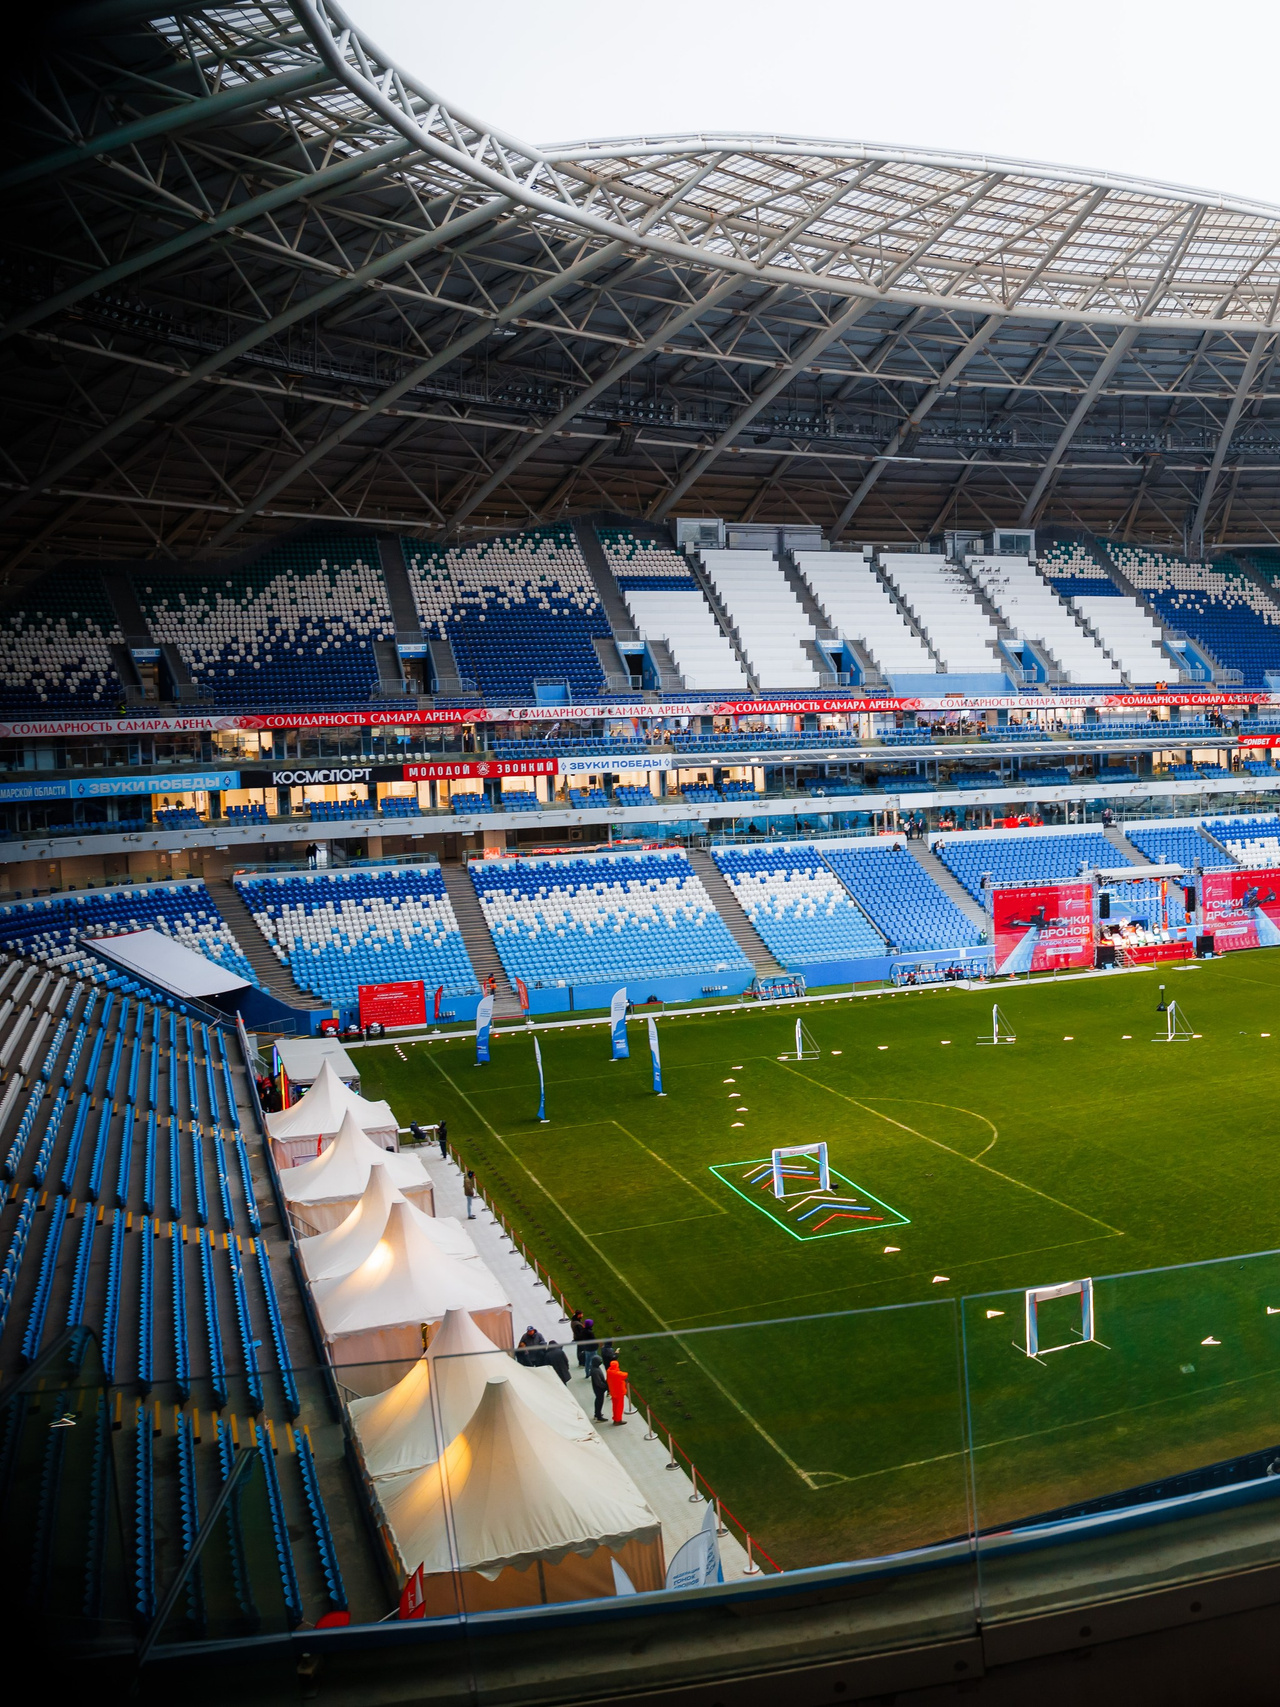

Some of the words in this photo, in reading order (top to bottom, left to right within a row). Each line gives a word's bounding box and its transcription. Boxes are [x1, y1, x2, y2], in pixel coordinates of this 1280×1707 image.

[1018, 697, 1056, 707] САМАРА
[1059, 697, 1087, 706] АРЕНА
[1121, 695, 1189, 705] СОЛИДАРНОСТЬ
[1191, 695, 1226, 704] САМАРА
[658, 705, 691, 715] АРЕНА
[736, 701, 820, 713] СОЛИДАРНОСТЬ
[823, 700, 866, 711] САМАРА
[869, 700, 900, 709] АРЕНА
[266, 714, 366, 727] СОЛИДАРНОСТЬ
[370, 713, 421, 724] САМАРА
[424, 711, 462, 721] АРЕНА
[12, 722, 112, 735] СОЛИДАРНОСТЬ
[117, 720, 169, 731] САМАРА
[409, 764, 470, 777] МОЛОДОЙ
[497, 761, 554, 774] ЗВОНКИЙ
[569, 760, 610, 770] ЗВУКИ
[612, 759, 662, 769] ПОБЕДЫ
[34, 785, 67, 797] ОБЛАСТИ
[89, 780, 146, 794] ЗВУКИ
[148, 777, 220, 792] ПОБЕДЫ
[1206, 898, 1244, 910] ГОНКИ
[1049, 915, 1090, 926] ГОНКИ
[1039, 926, 1090, 940] ДРОНОВ
[673, 1574, 696, 1586] ГОНОК
